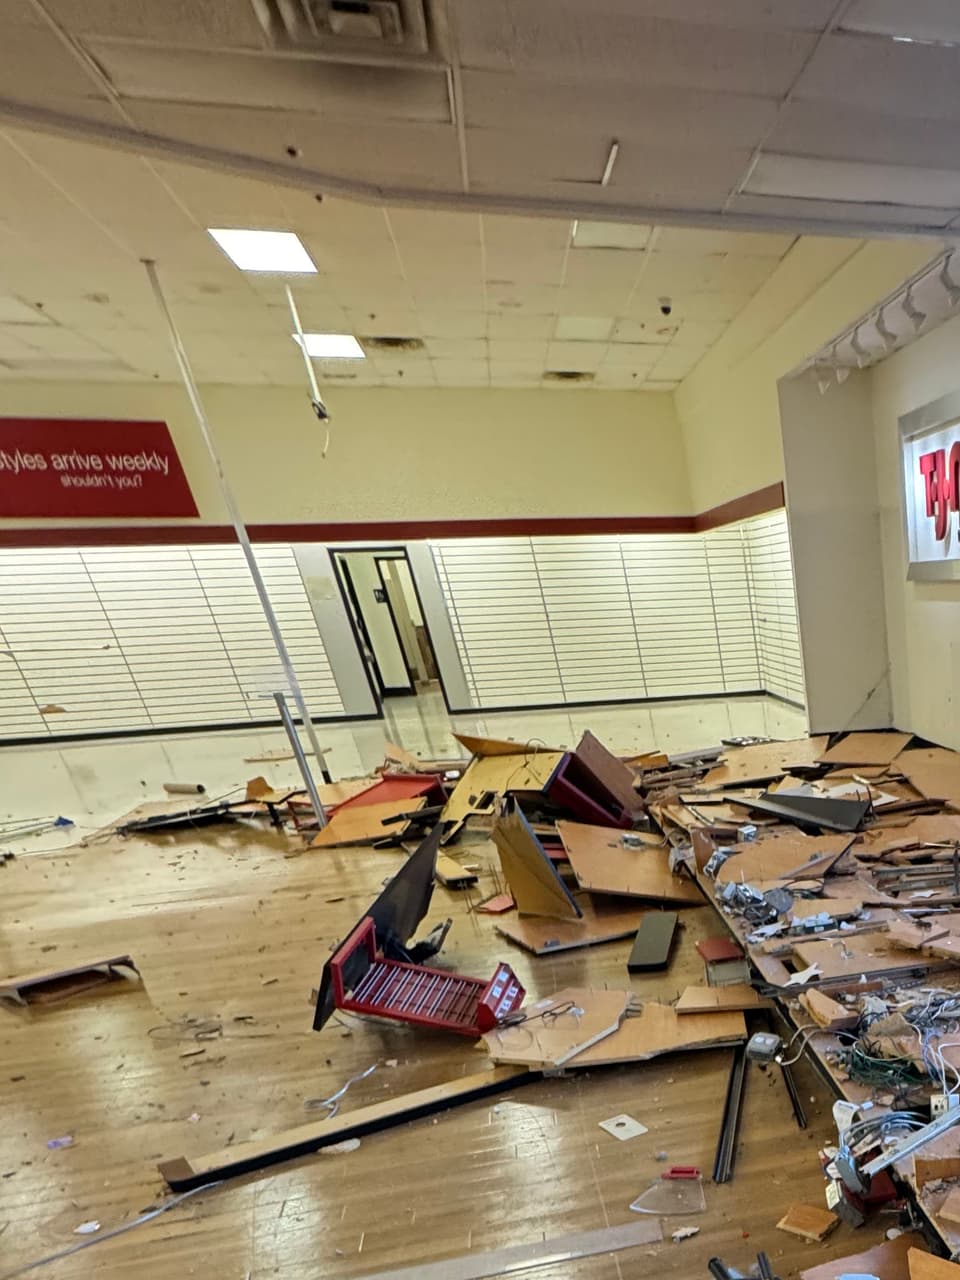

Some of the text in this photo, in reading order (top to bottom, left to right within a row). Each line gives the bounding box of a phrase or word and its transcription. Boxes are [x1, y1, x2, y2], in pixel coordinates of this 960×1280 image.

[51, 450, 103, 470] arrive
[106, 451, 169, 476] weekly
[61, 474, 143, 489] shouldn't you?
